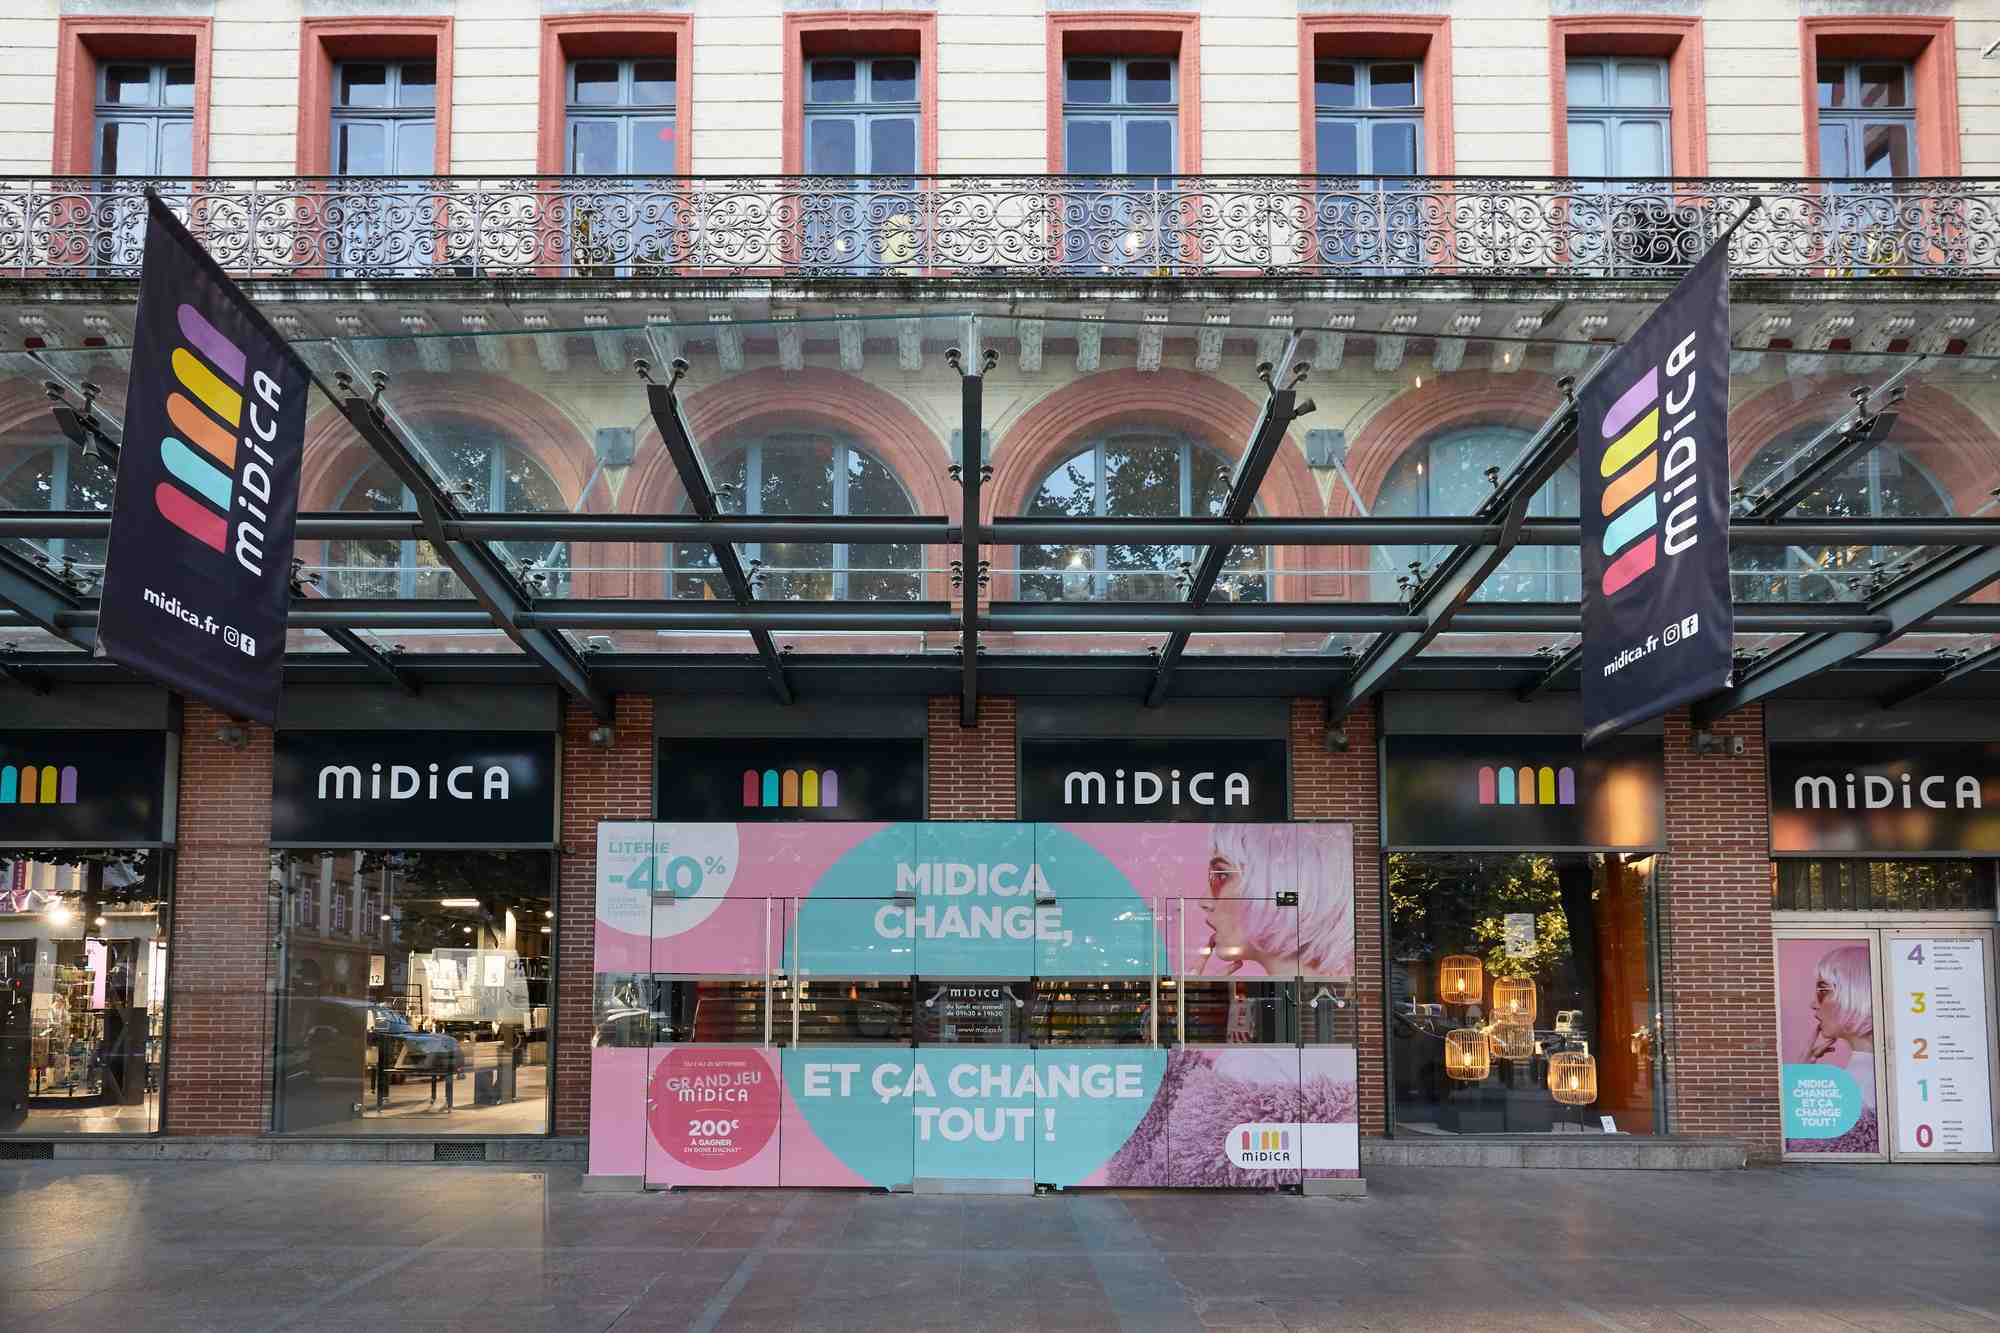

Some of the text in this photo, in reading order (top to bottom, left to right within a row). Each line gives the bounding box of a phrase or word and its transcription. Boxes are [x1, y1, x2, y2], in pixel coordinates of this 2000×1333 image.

[143, 588, 220, 635] midica.fr
[1603, 635, 1660, 677] midica.fr
[896, 862, 1051, 897] MIDICA
[873, 903, 1074, 946] CHANGE,
[1907, 943, 1926, 966] 4
[1909, 991, 1927, 1015] 3
[1912, 1038, 1929, 1060] 2
[666, 1071, 761, 1091] GRAND JEU
[803, 1062, 1144, 1104] ET ÇA CHANGE
[1917, 1079, 1929, 1102] 1
[914, 1106, 1035, 1142] TOUT
[1915, 1123, 1934, 1149] 0
